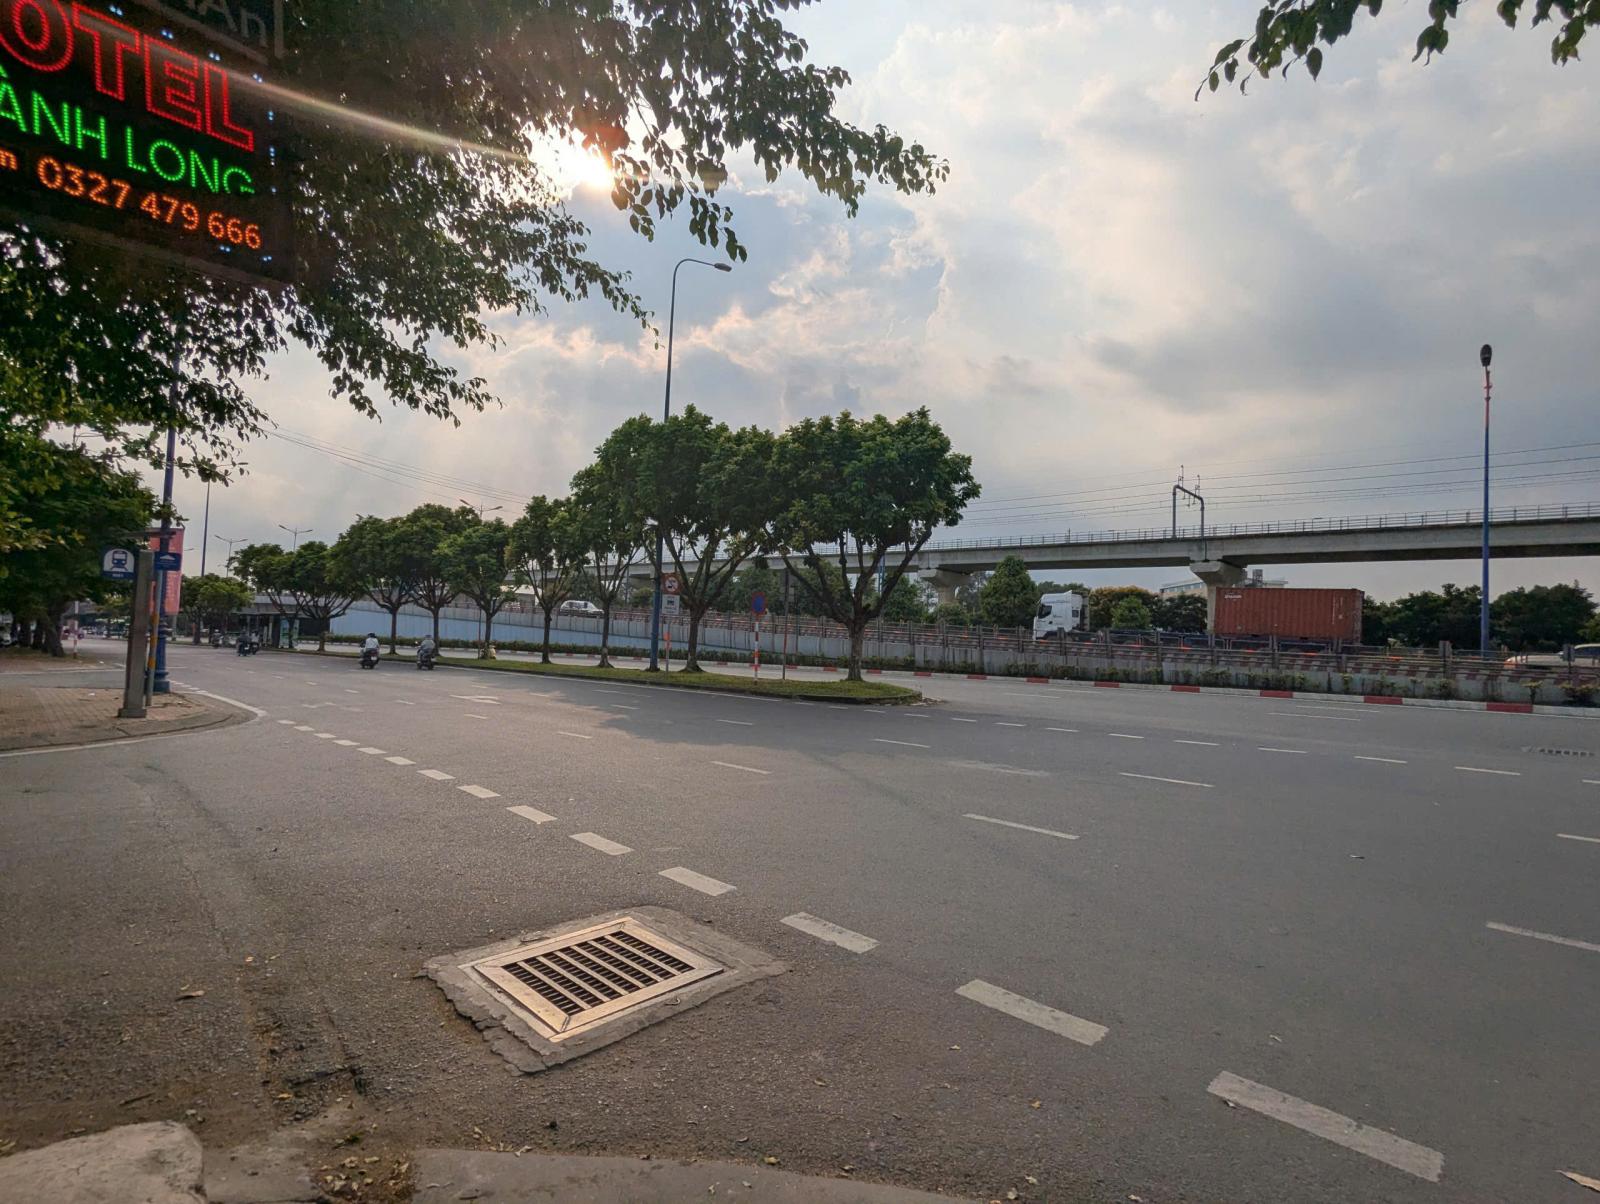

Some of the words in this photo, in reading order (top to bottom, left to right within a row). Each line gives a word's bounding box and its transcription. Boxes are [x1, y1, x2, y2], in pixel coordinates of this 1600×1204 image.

[126, 127, 256, 194] LONG
[37, 158, 131, 209] 0327
[140, 192, 200, 231] 479
[207, 212, 261, 249] 666
